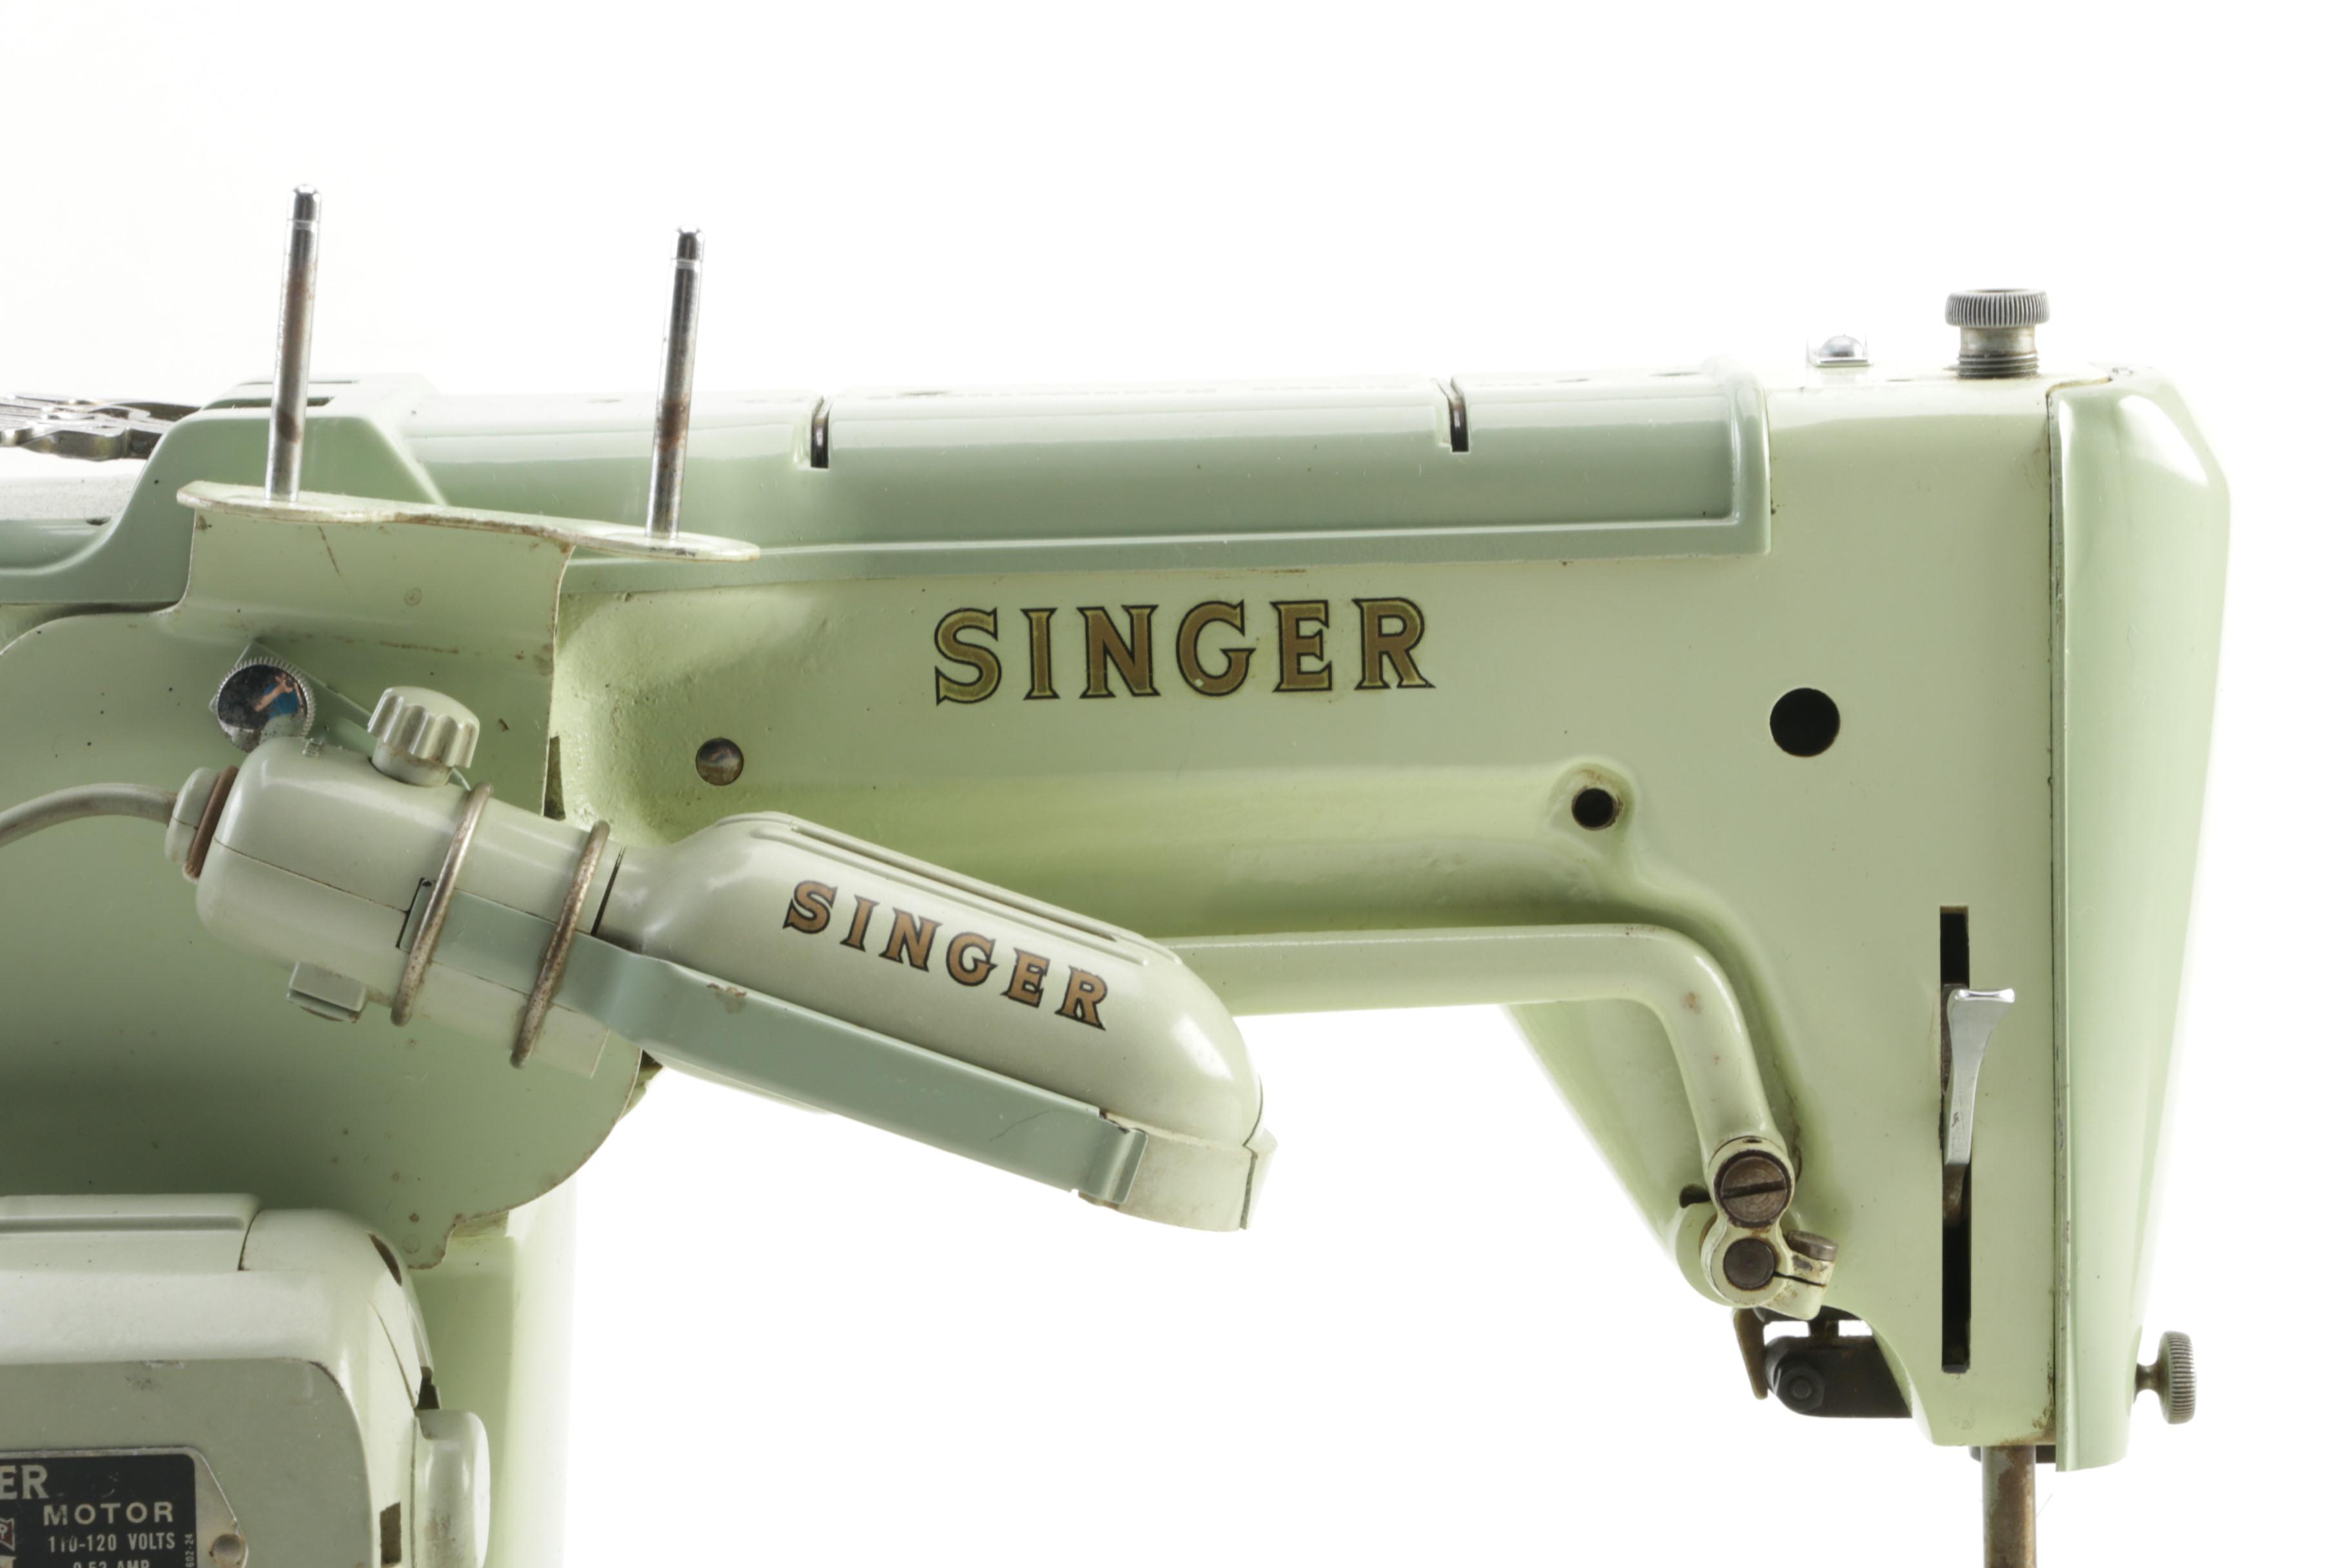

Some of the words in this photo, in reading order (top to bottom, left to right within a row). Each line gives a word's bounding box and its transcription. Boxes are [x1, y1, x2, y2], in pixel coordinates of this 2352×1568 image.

[934, 597, 1436, 705] SINGER
[782, 881, 1108, 1032] SINGER
[43, 1502, 173, 1526] MOTOR
[48, 1534, 117, 1553] 110-120
[128, 1533, 175, 1550] VOLTS
